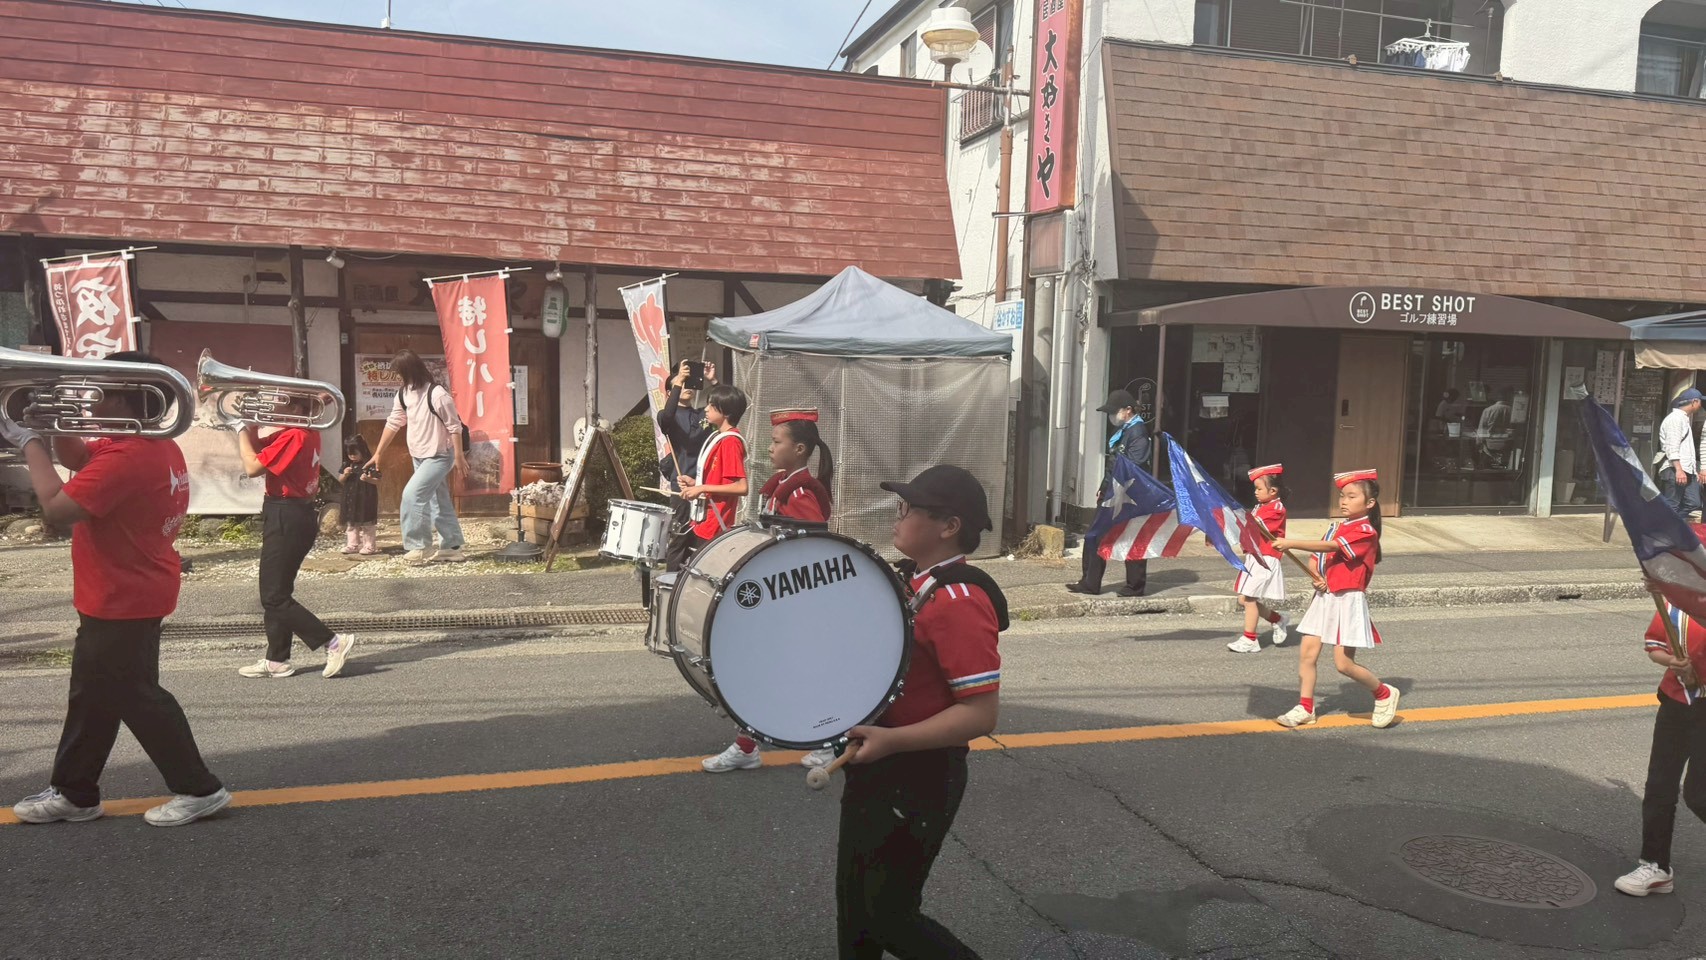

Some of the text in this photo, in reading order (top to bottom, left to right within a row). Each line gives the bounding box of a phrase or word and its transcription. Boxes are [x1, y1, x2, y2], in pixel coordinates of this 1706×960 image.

[1037, 29, 1058, 200] 大好きや
[1381, 293, 1476, 313] BEST SHOT
[1400, 312, 1458, 326] ゴルフ練習場
[762, 553, 858, 601] YAMAHA
